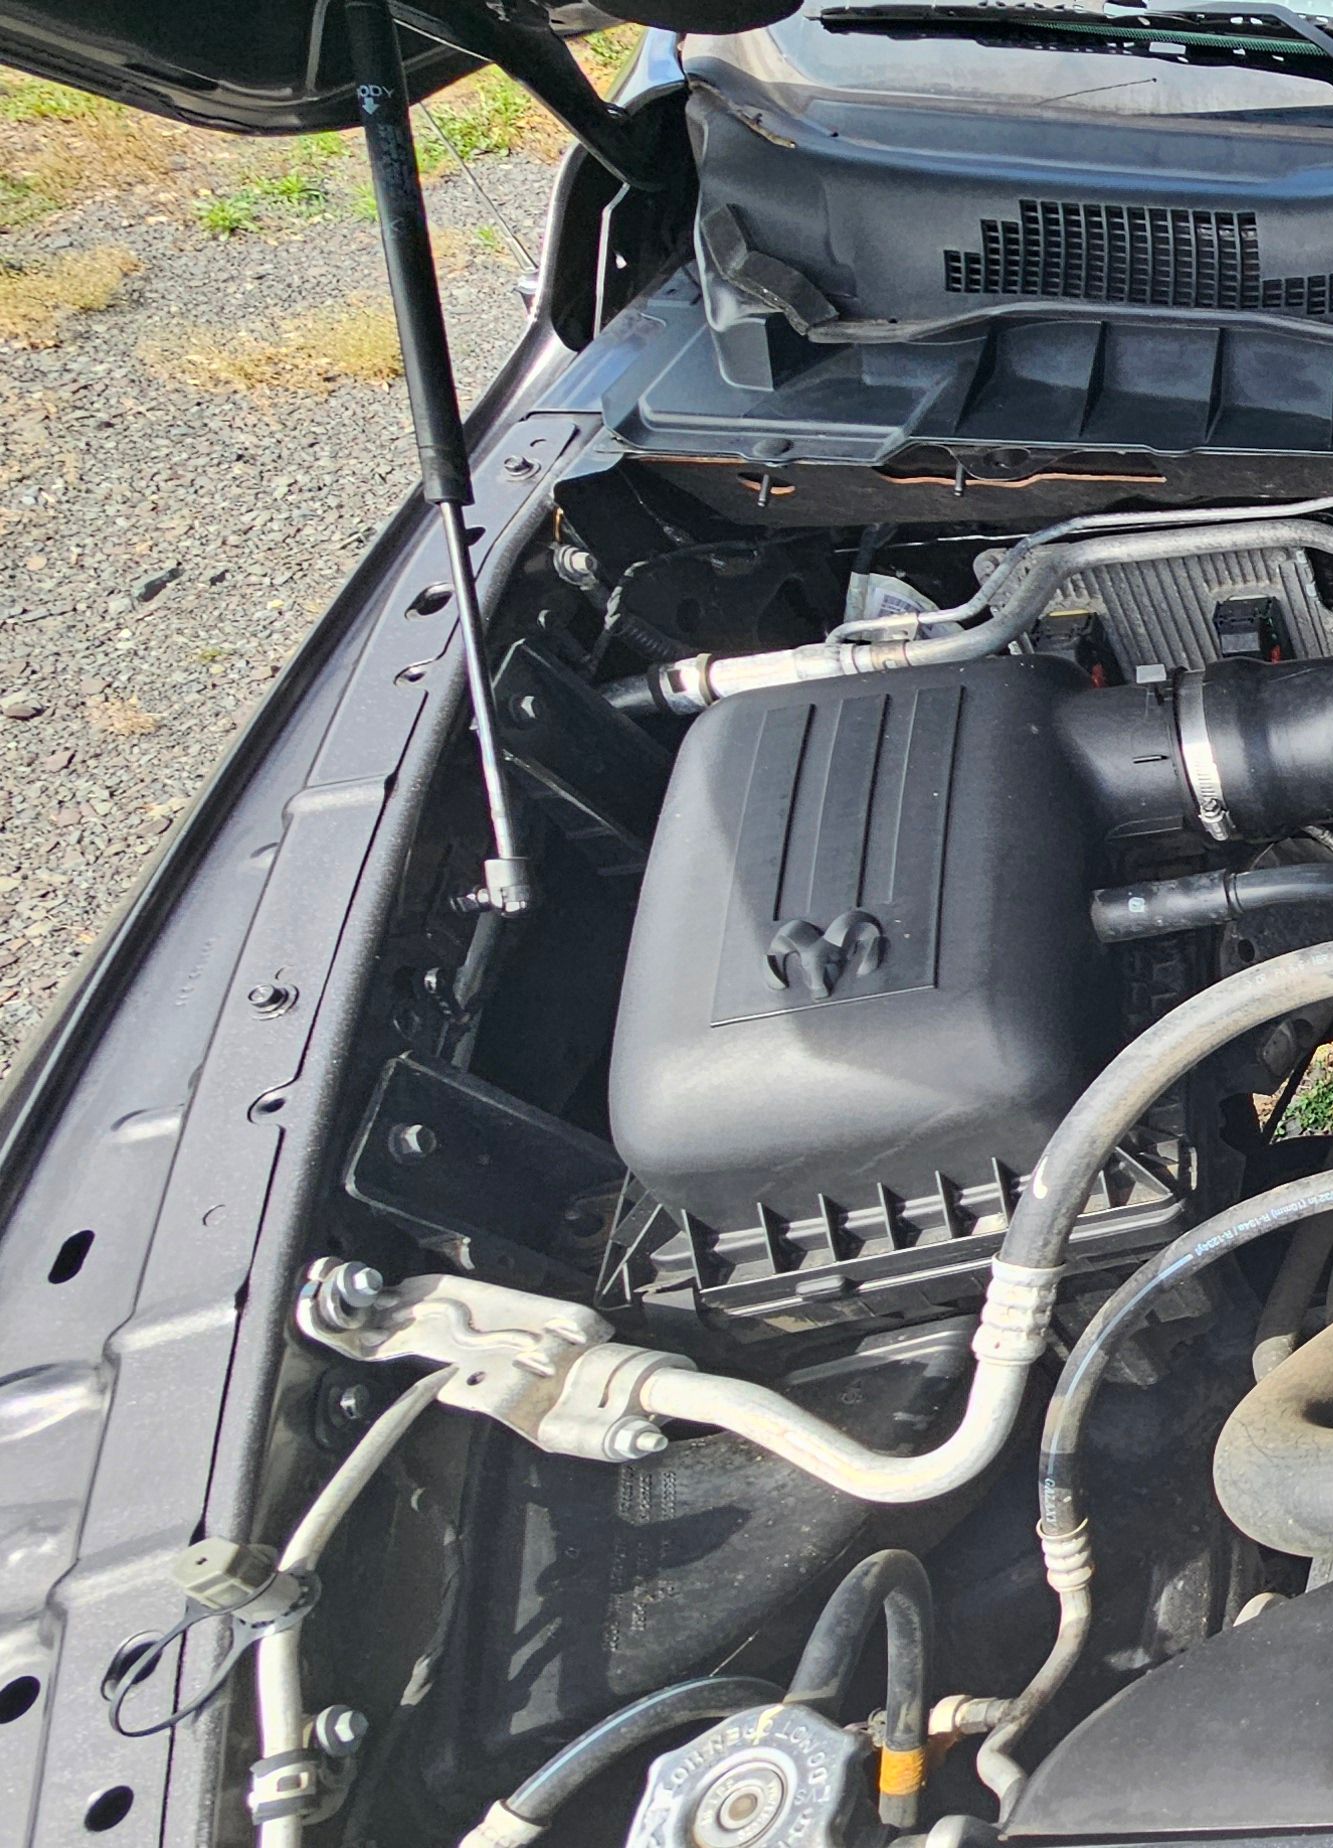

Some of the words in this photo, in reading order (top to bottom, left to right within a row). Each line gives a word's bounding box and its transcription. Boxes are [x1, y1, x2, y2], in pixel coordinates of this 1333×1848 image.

[1271, 1198, 1309, 1220] (10mm)
[1237, 1213, 1271, 1232] R-134a
[1194, 1230, 1234, 1256] R-1234yf
[1045, 1478, 1057, 1526] GALAXY
